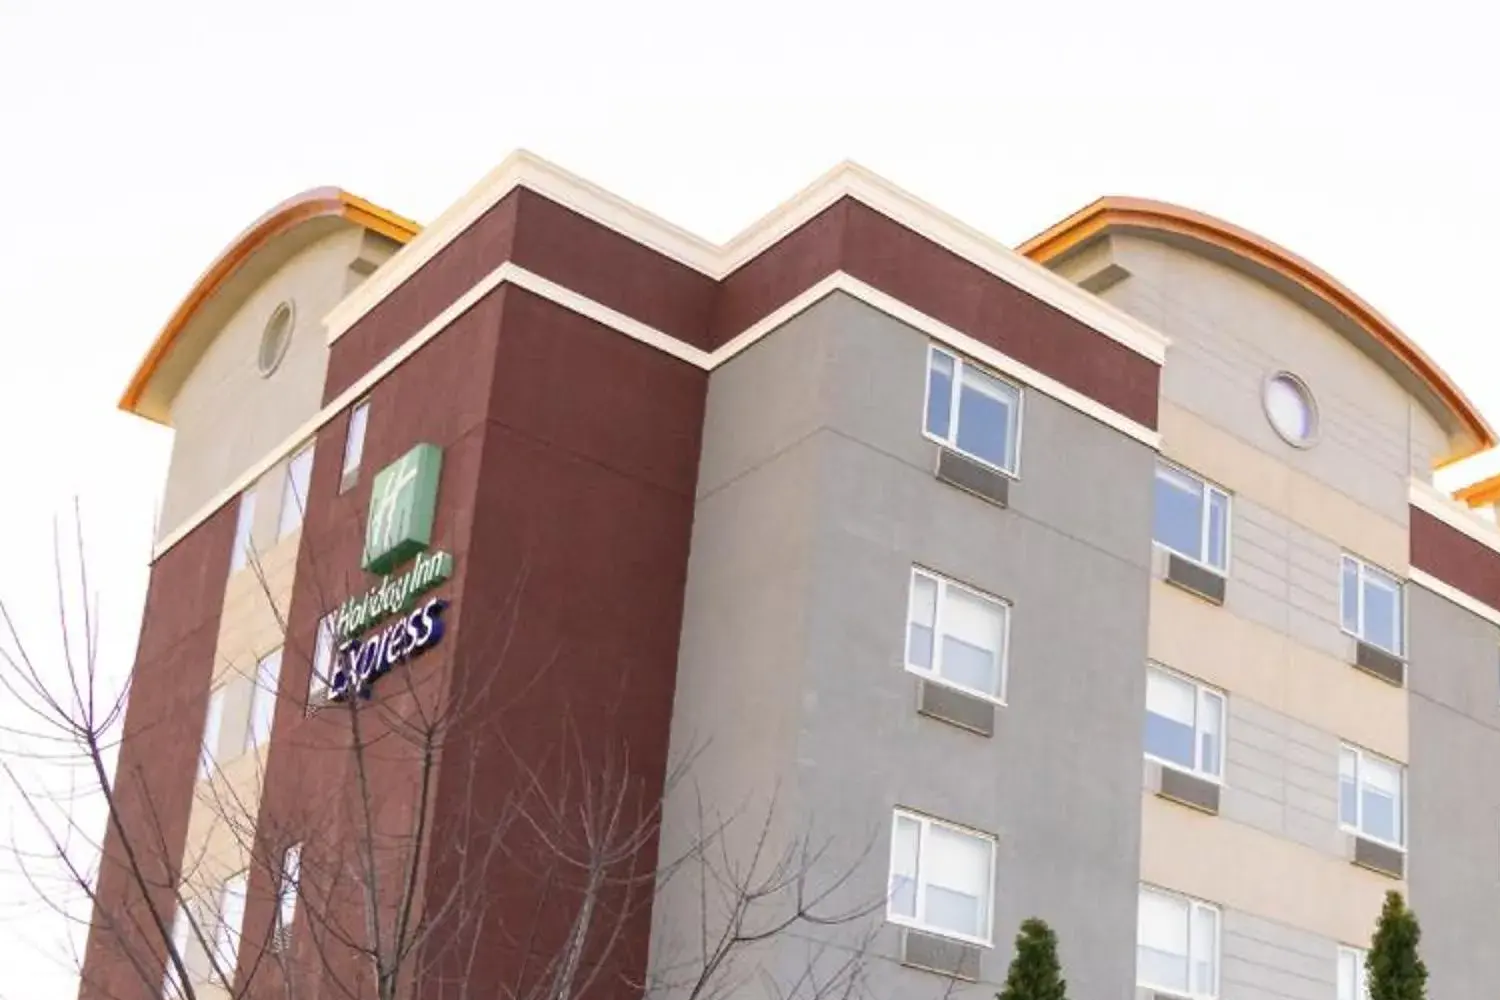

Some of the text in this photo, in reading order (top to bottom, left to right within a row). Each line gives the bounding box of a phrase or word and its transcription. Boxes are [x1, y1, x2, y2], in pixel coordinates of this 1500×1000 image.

[336, 550, 447, 636] Holiday Inn
[328, 597, 440, 699] Express
